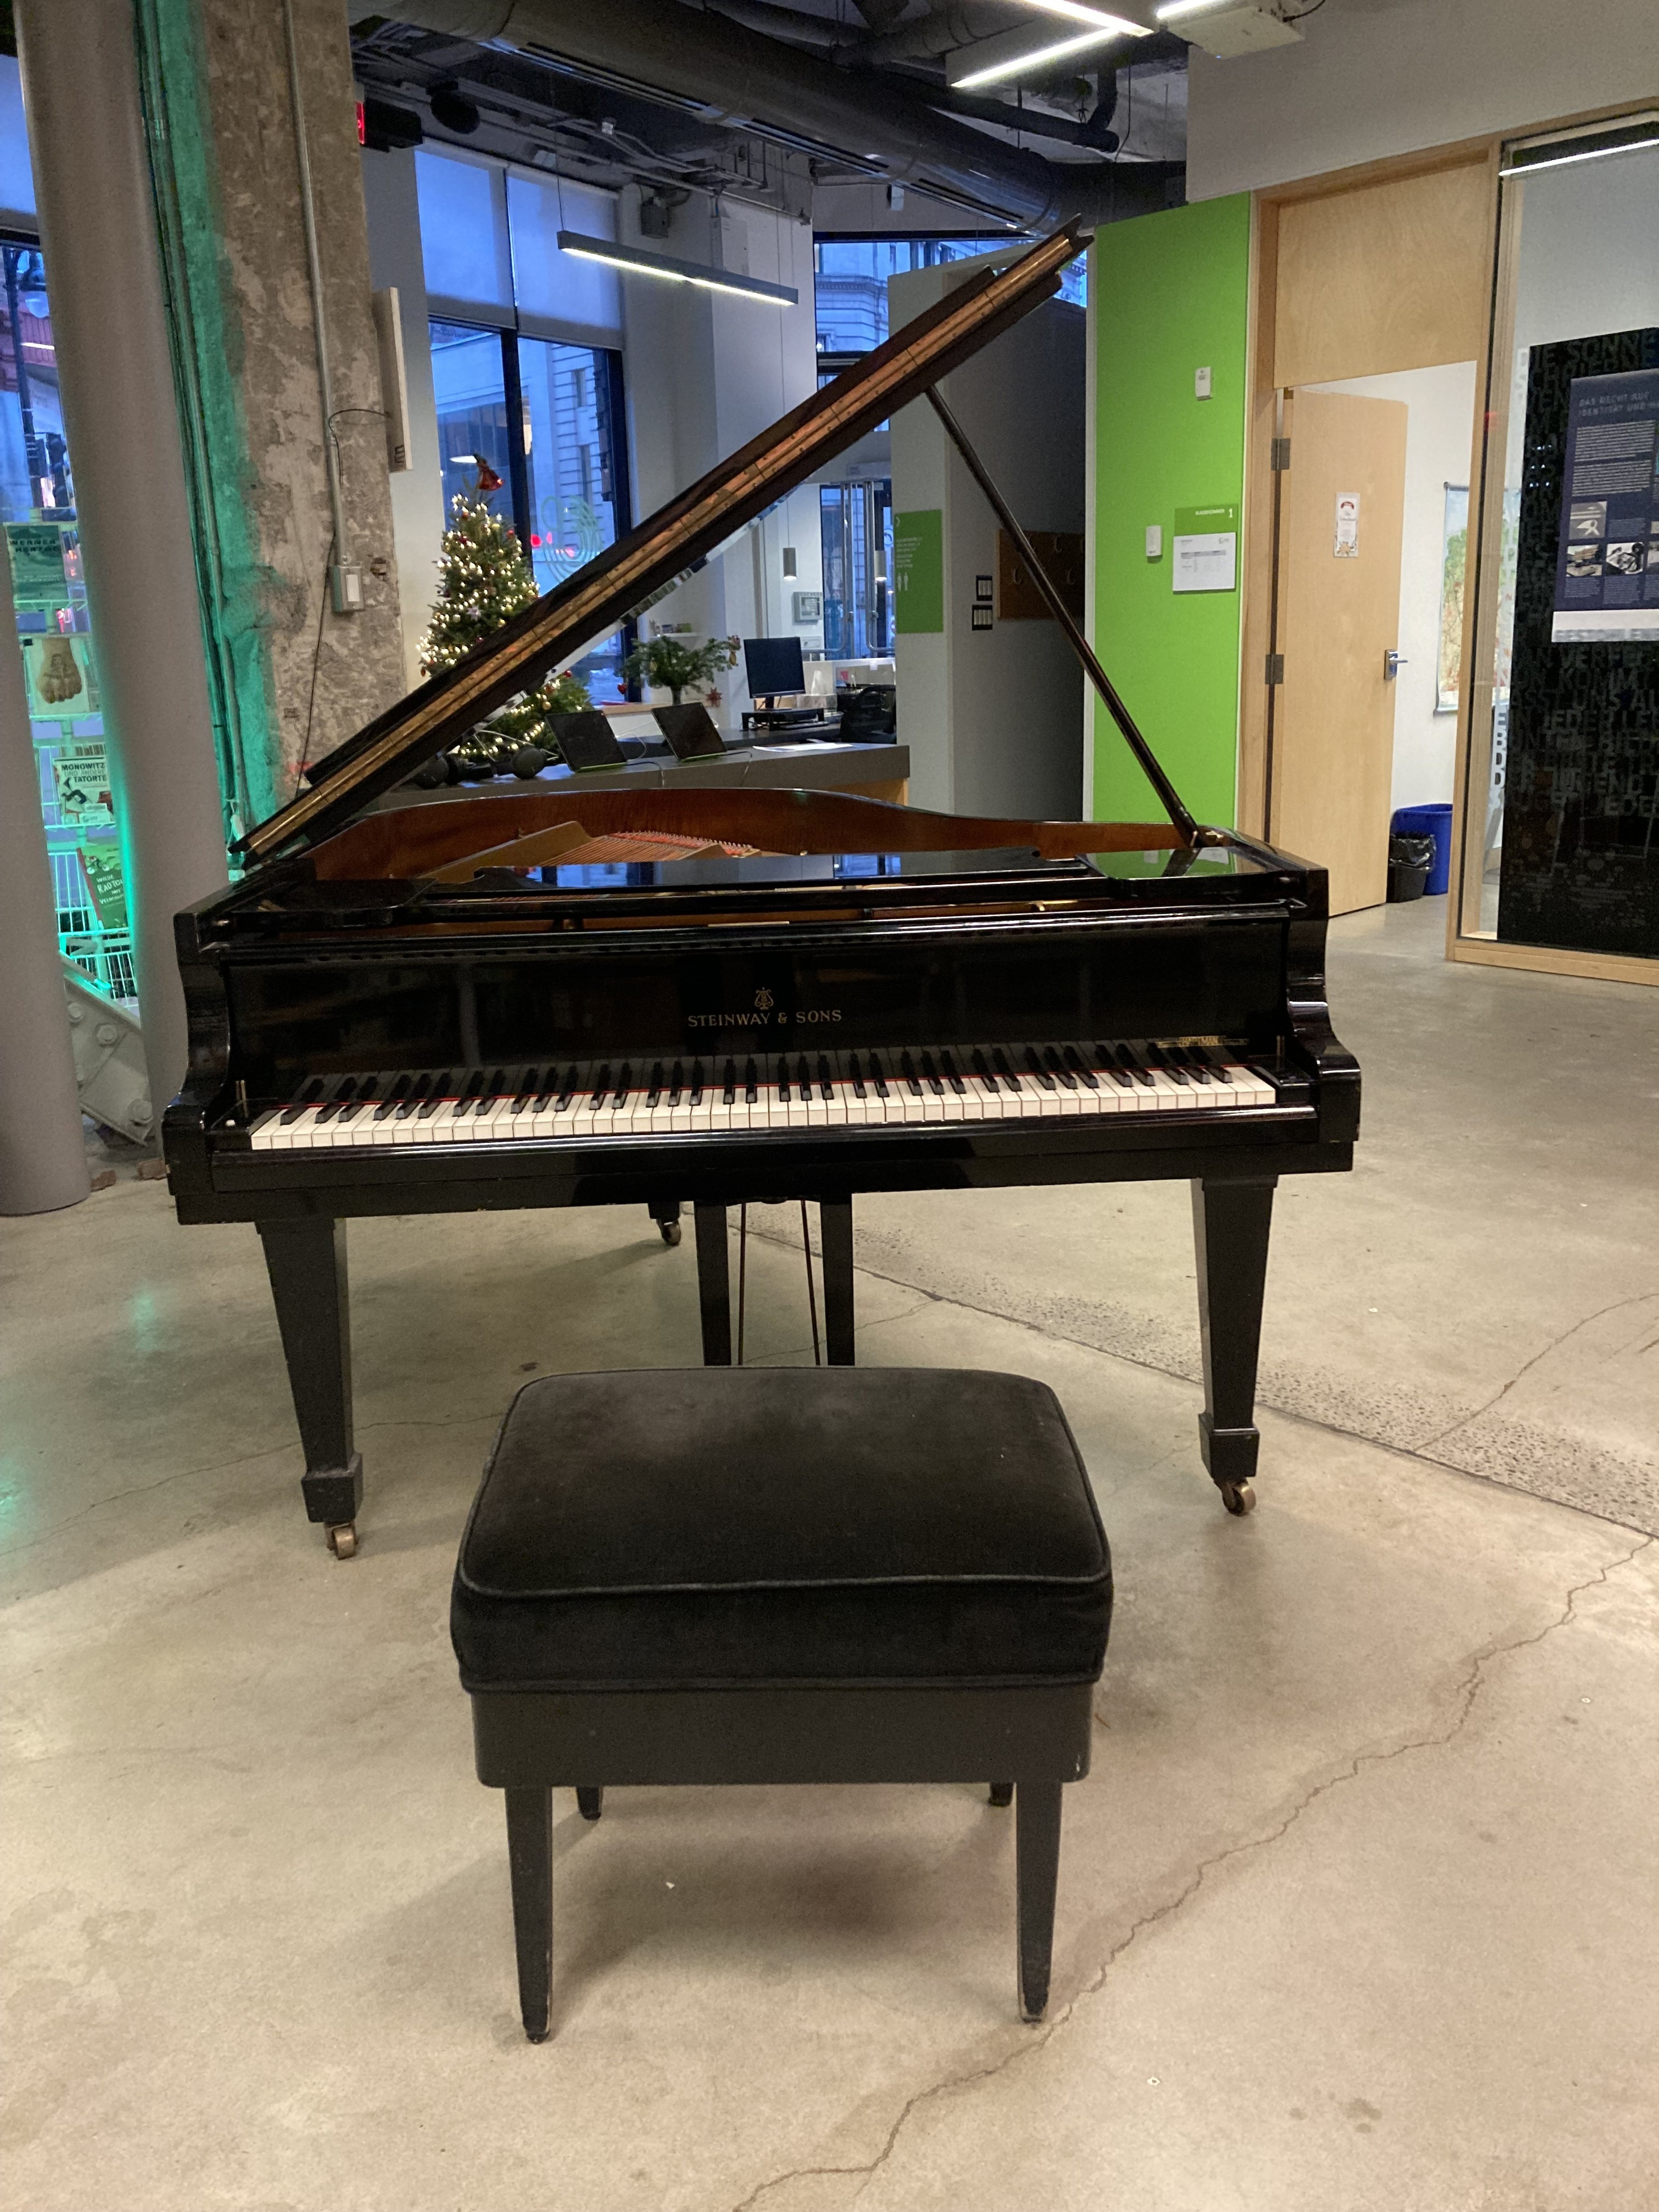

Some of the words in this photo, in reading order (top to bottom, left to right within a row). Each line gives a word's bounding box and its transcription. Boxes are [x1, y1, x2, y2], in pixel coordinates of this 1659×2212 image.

[1229, 508, 1233, 518] 1
[74, 775, 107, 783] TATORTE
[96, 874, 114, 883] WILDE
[688, 1013, 771, 1027] STEINWAY
[778, 1012, 788, 1024] &
[796, 1009, 842, 1023] SONS
